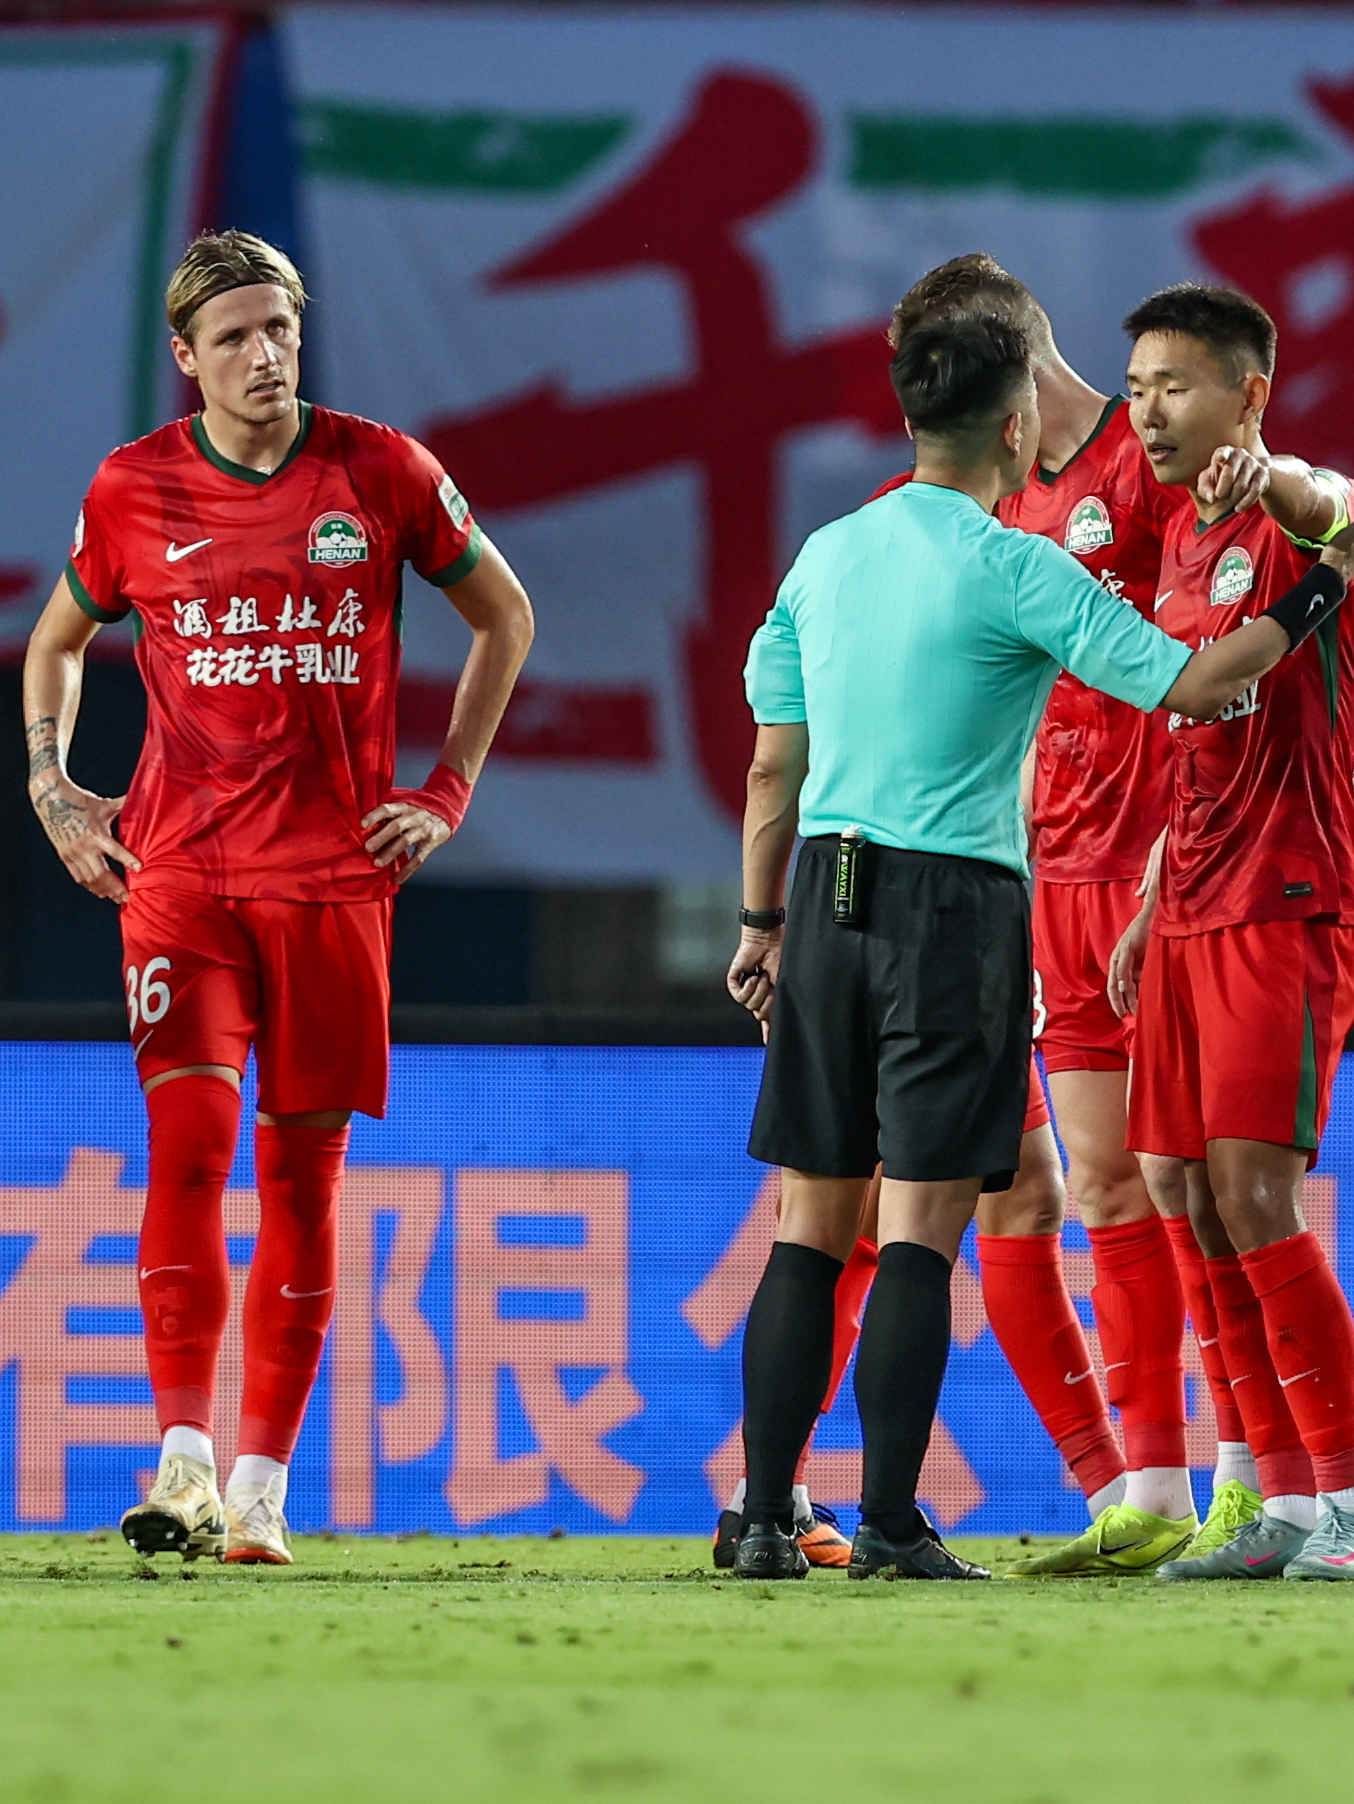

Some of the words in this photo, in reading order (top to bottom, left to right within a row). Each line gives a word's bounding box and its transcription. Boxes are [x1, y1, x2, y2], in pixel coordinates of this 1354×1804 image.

[1068, 531, 1106, 549] HENAN
[315, 548, 361, 560] HENAN
[1215, 579, 1249, 602] HENAN
[186, 644, 360, 687] 花花牛乳业
[126, 956, 170, 1035] 36
